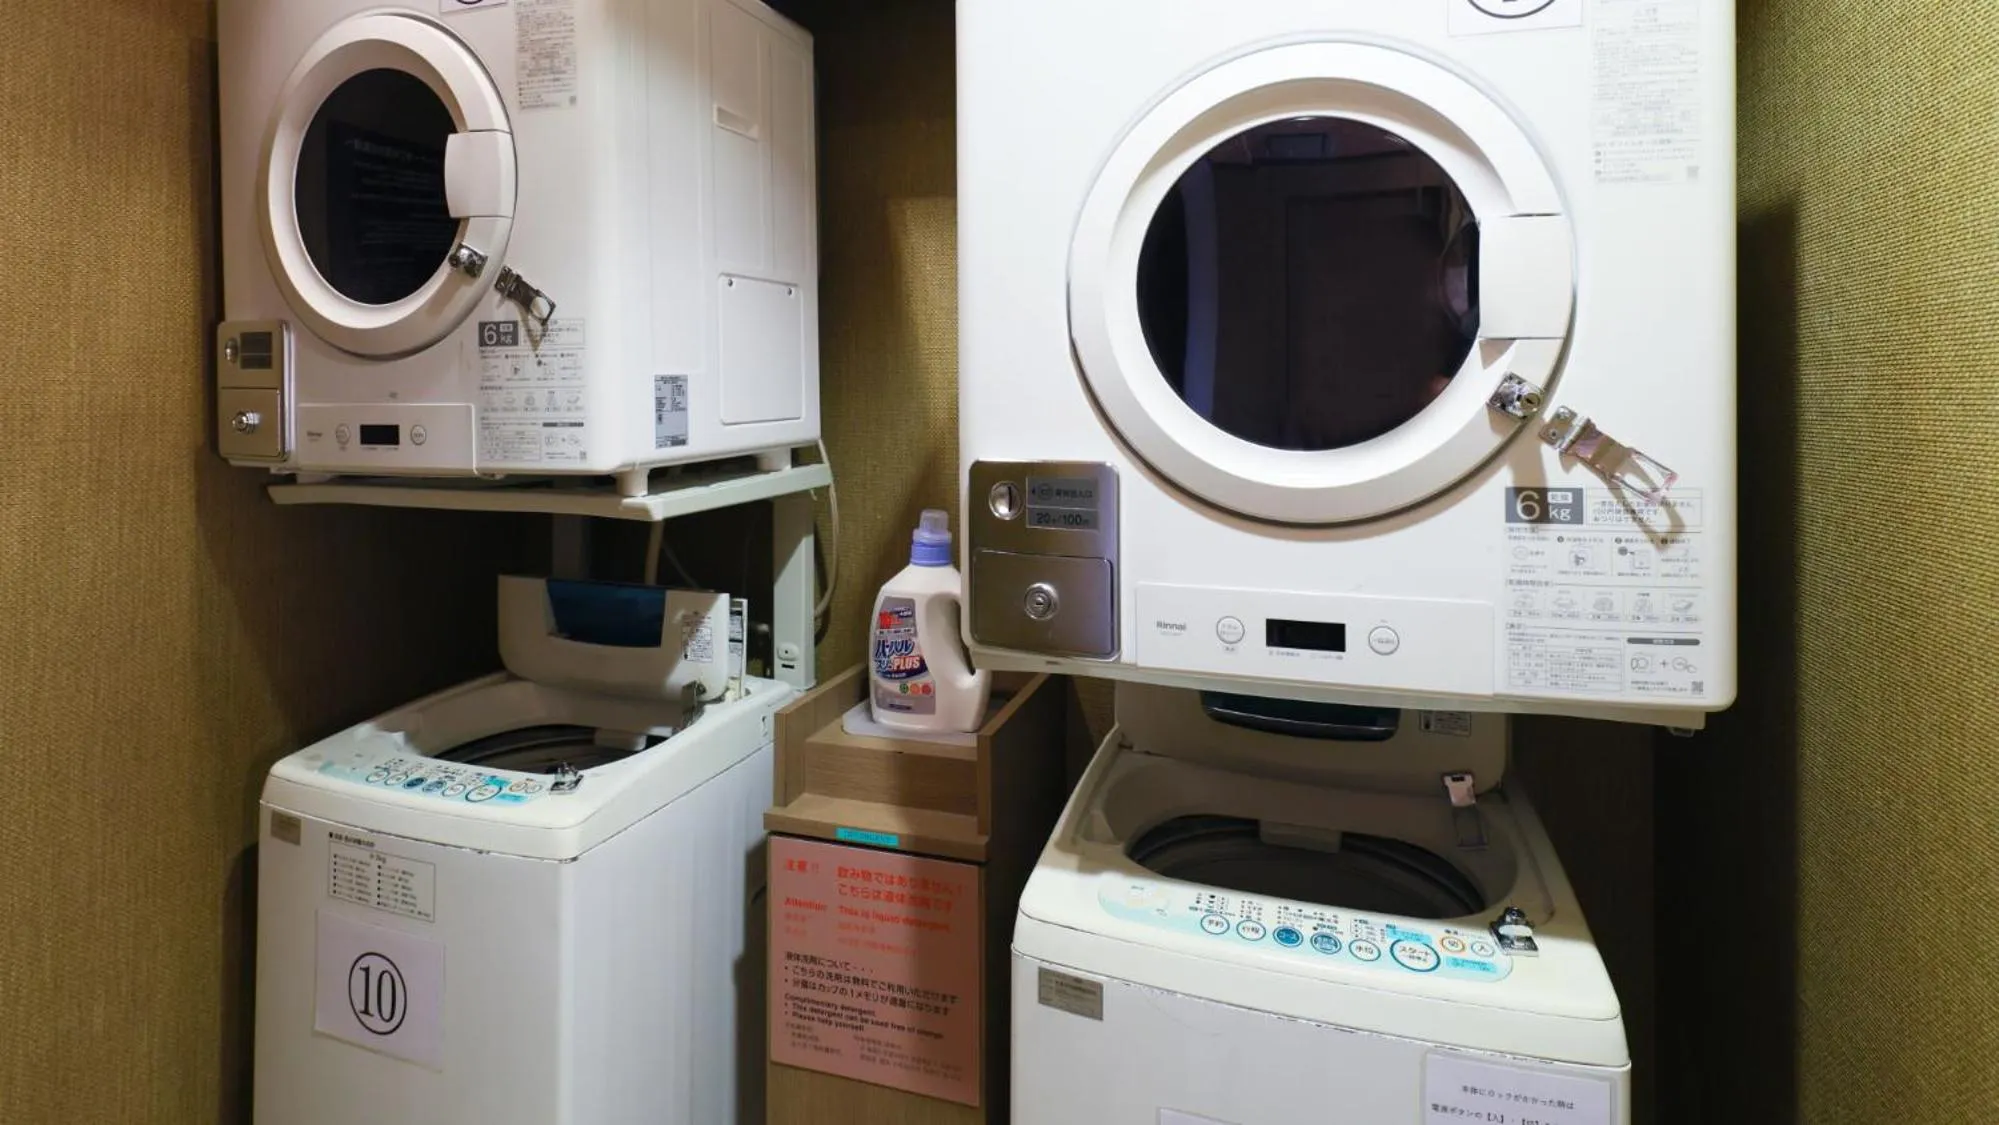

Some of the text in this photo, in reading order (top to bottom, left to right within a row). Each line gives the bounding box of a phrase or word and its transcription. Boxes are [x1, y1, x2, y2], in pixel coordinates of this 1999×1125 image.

[484, 323, 497, 344] 6
[500, 334, 512, 345] kg
[1515, 490, 1540, 520] 6
[1549, 505, 1572, 522] kg
[892, 656, 920, 671] PLUS
[359, 964, 397, 1024] 10
